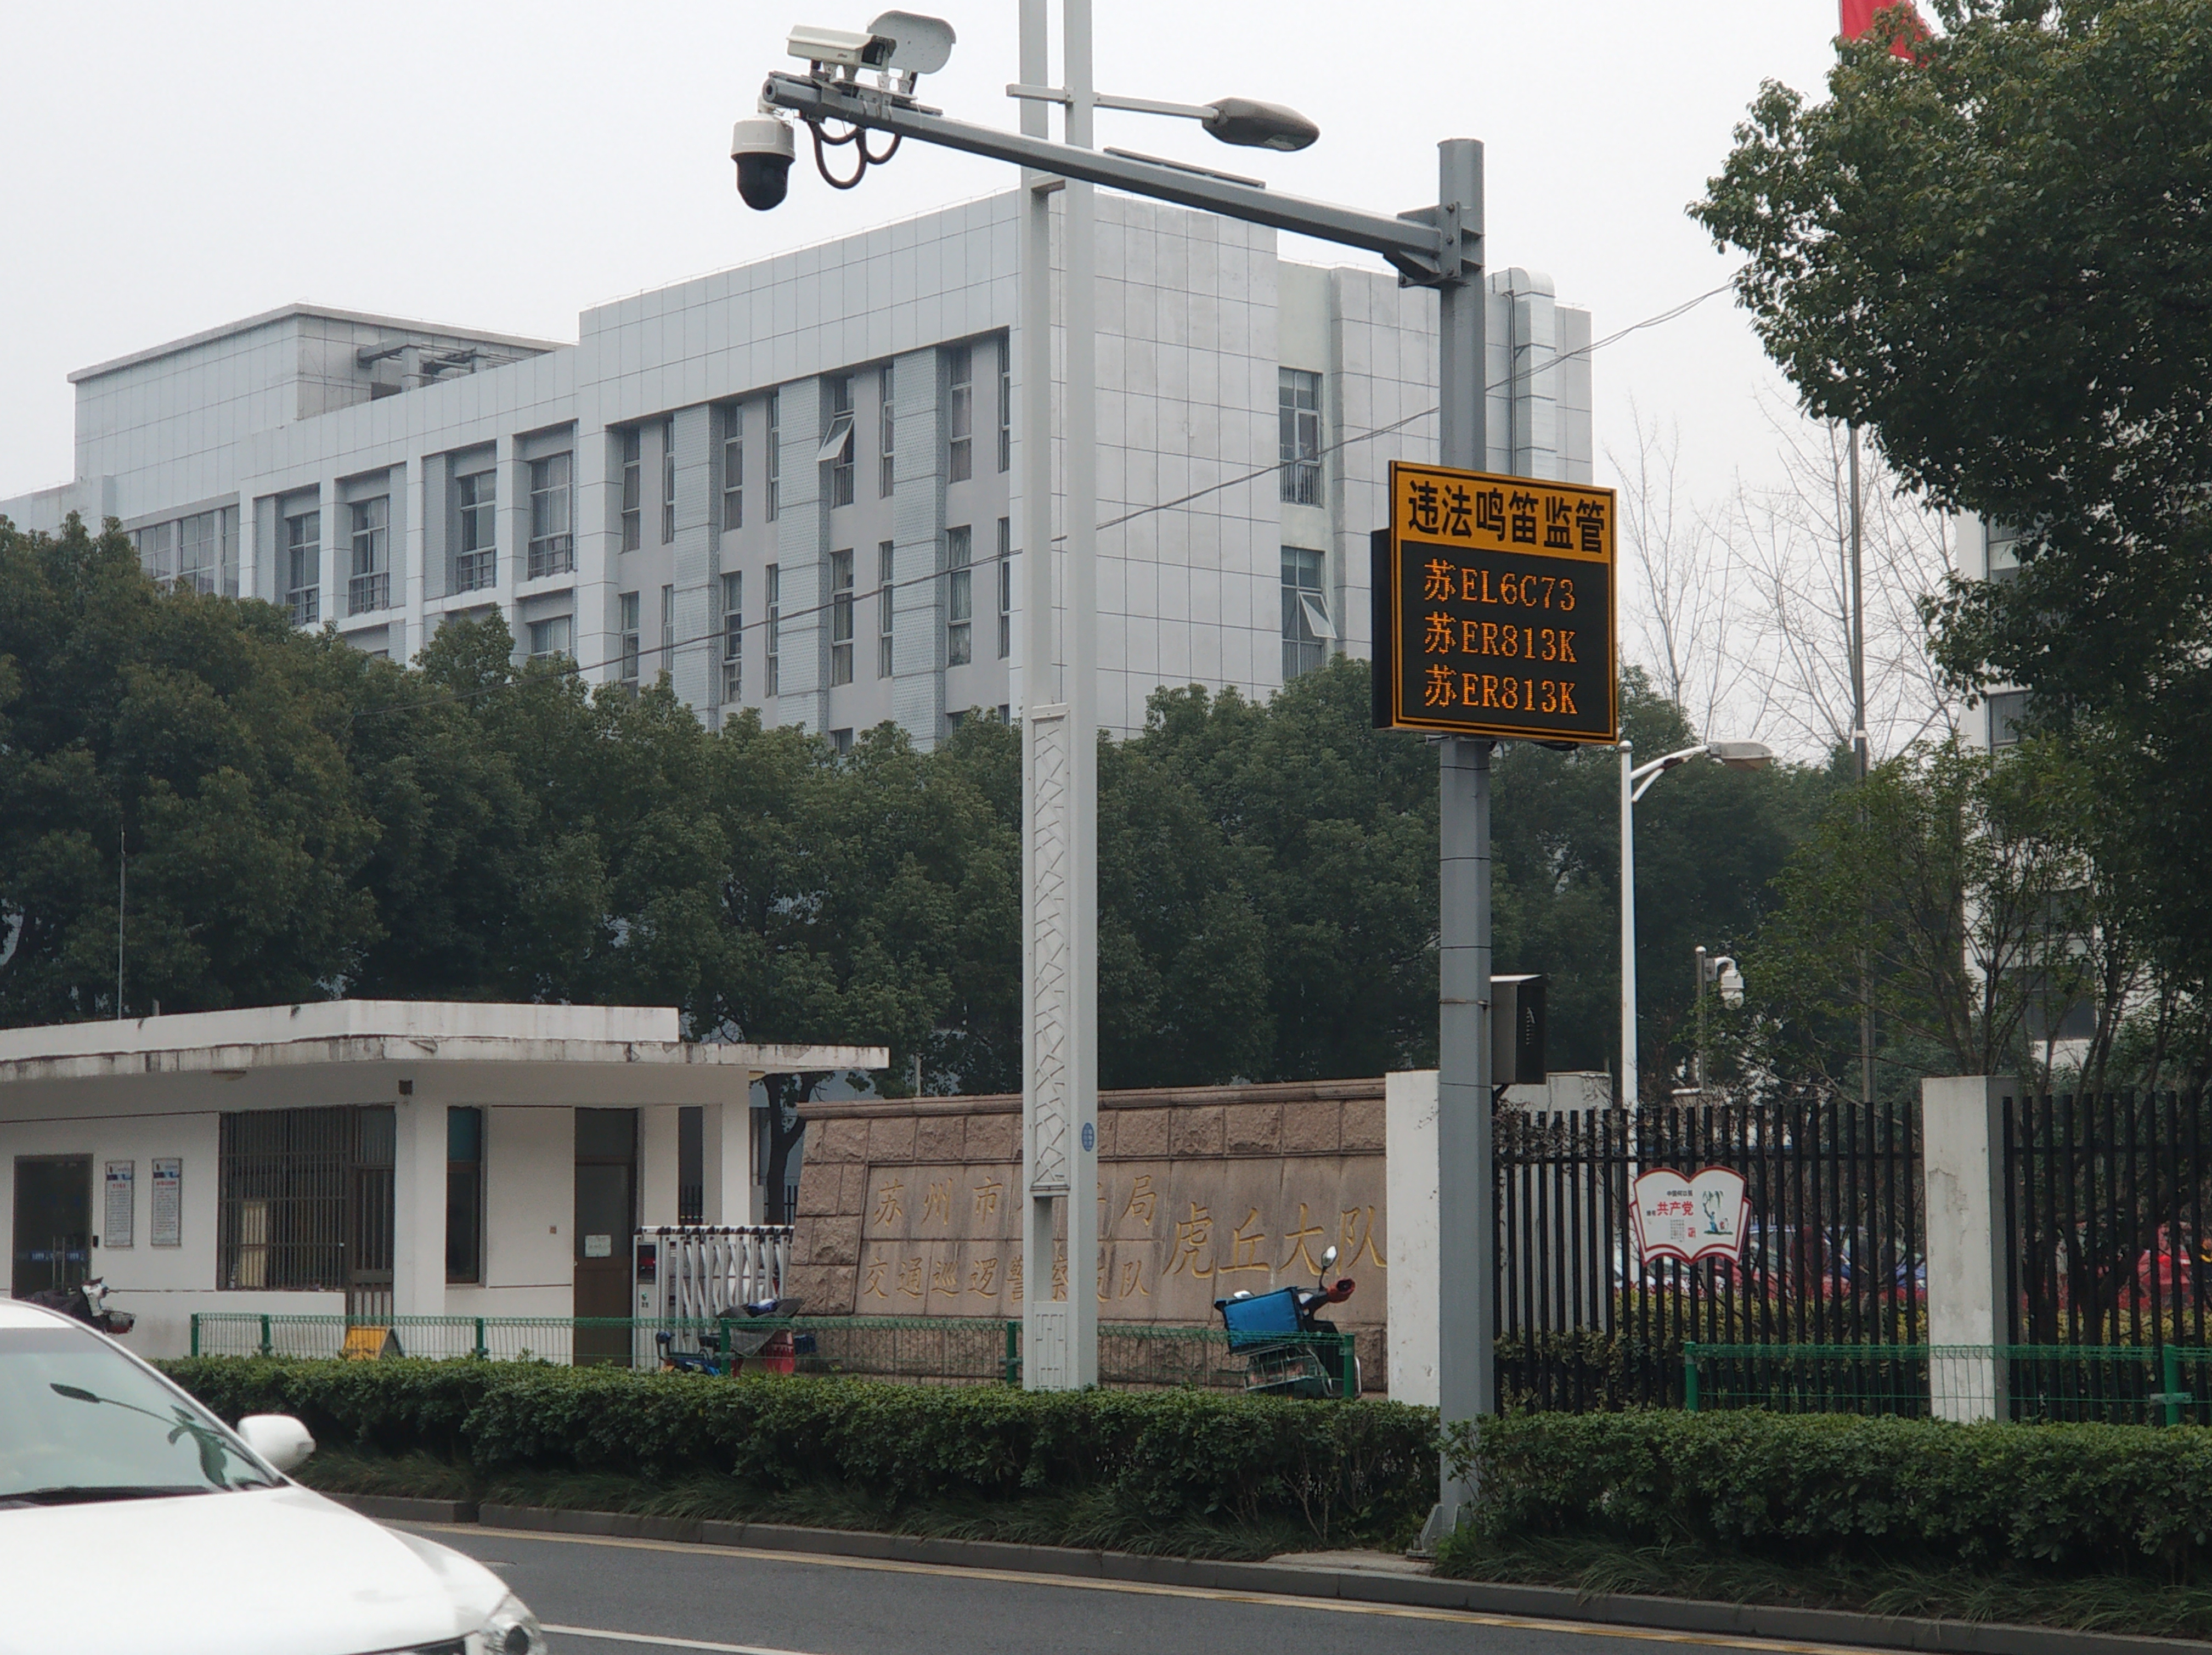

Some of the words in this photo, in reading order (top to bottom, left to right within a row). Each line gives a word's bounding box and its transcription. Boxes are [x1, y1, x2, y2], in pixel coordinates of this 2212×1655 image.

[1408, 480, 1605, 554] 违法鸣笛监管
[1424, 558, 1576, 611] 苏EL6C73
[1424, 611, 1578, 663] 苏ER813K
[1425, 663, 1578, 714] 苏ER813K
[873, 1174, 1157, 1226] 苏州市局
[1657, 1201, 1694, 1216] 共产党
[1162, 1202, 1387, 1279] 虎丘大队
